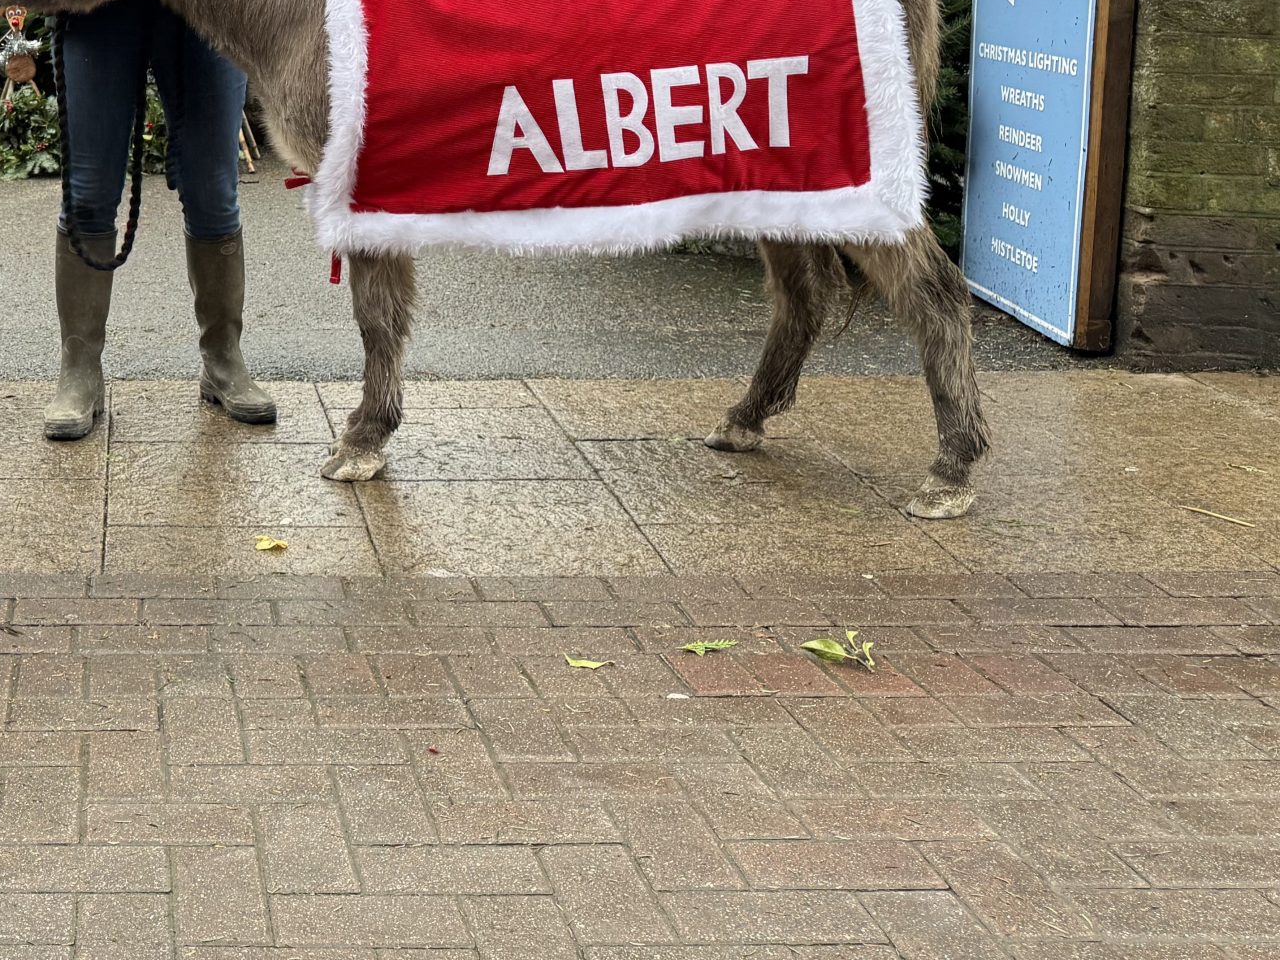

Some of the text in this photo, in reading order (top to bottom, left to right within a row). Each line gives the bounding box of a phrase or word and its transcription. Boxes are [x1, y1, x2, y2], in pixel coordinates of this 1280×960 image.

[978, 42, 1078, 76] CHRISTMAS LIGHTING
[1000, 85, 1045, 112] WREATHS
[486, 55, 809, 176] ALBERT
[998, 124, 1043, 153] REINDEER
[995, 159, 1043, 191] SNOWMEN
[1002, 202, 1031, 228] HOLLY
[991, 237, 1039, 273] MISTLETOE
